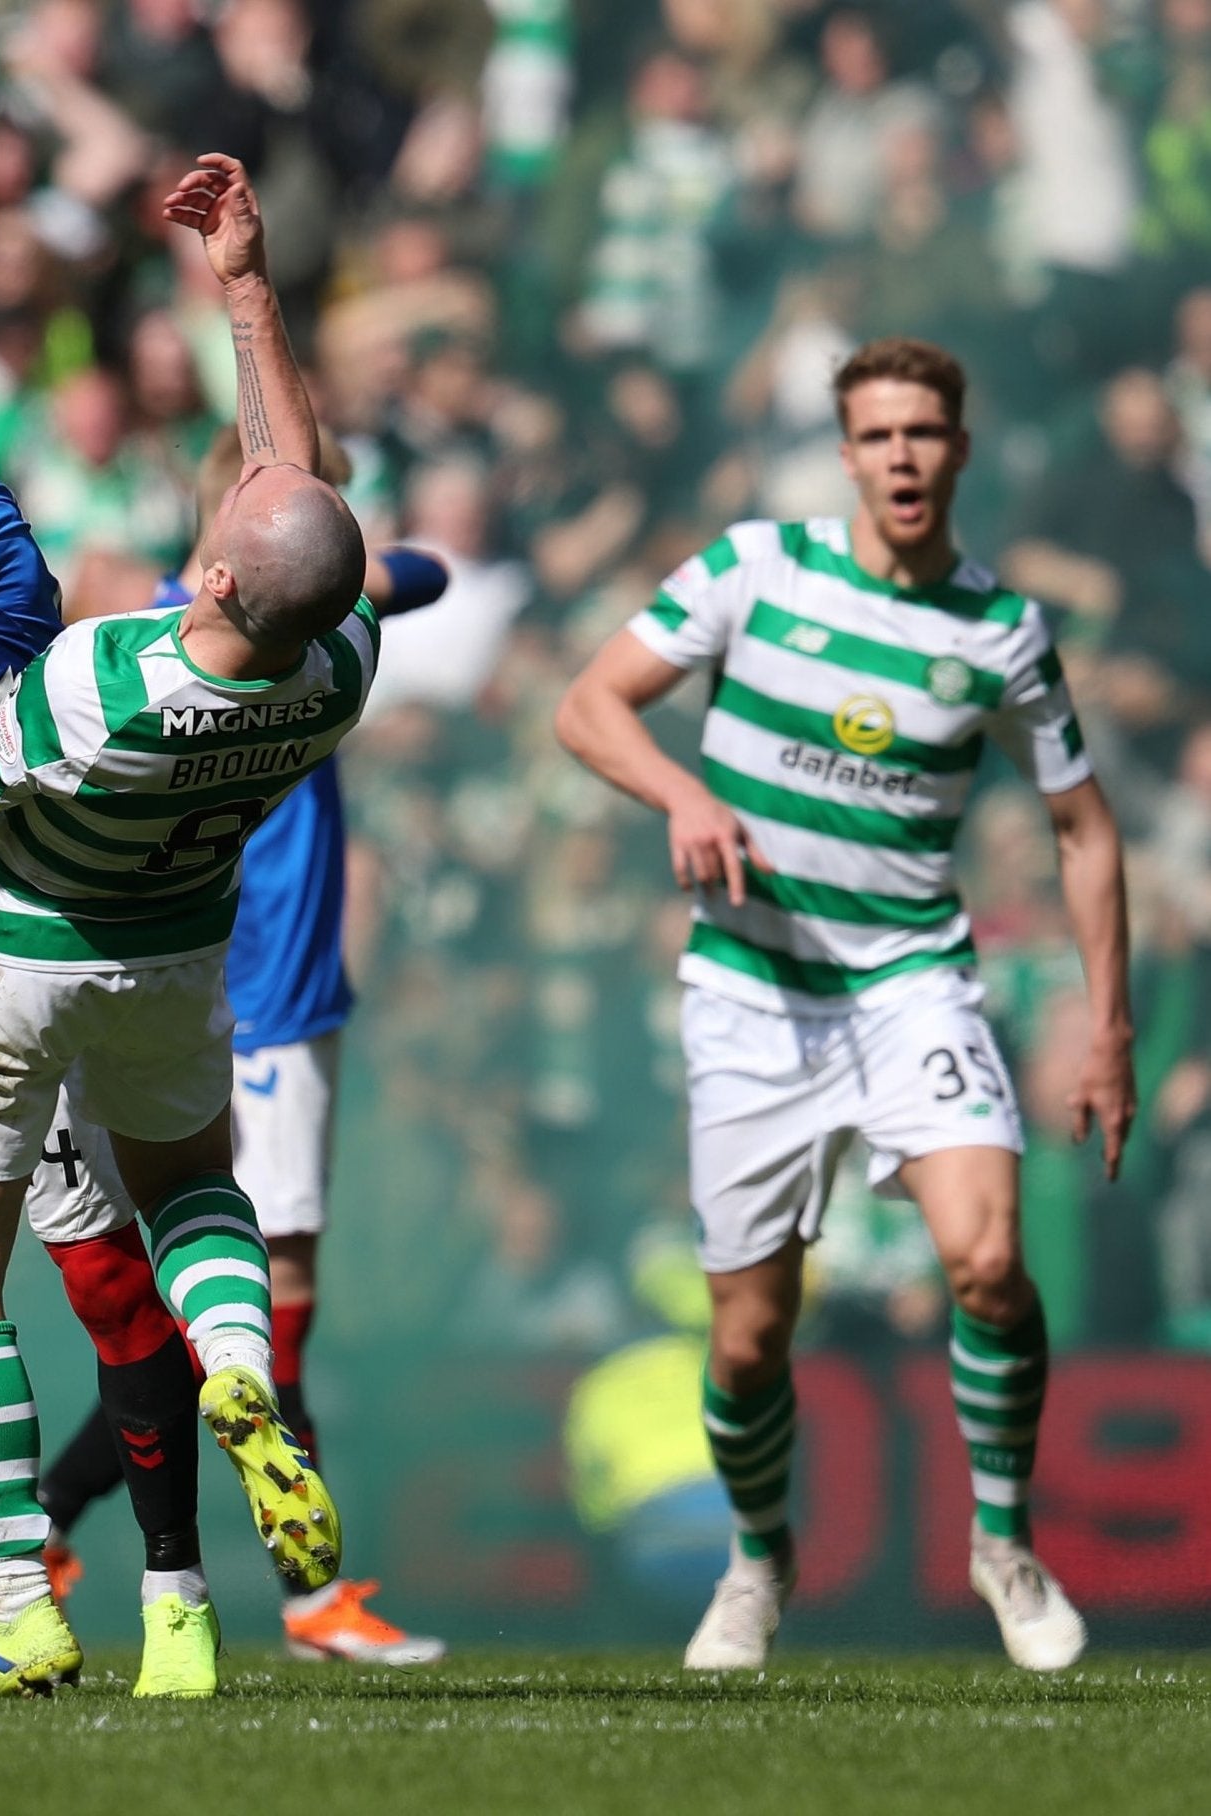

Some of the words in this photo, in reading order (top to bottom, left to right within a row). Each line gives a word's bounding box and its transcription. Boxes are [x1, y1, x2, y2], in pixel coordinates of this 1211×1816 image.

[162, 696, 323, 738] MAGNERS
[167, 741, 311, 790] BROWN
[777, 740, 919, 796] dafabet
[133, 796, 268, 875] 8
[921, 1045, 1005, 1103] 35
